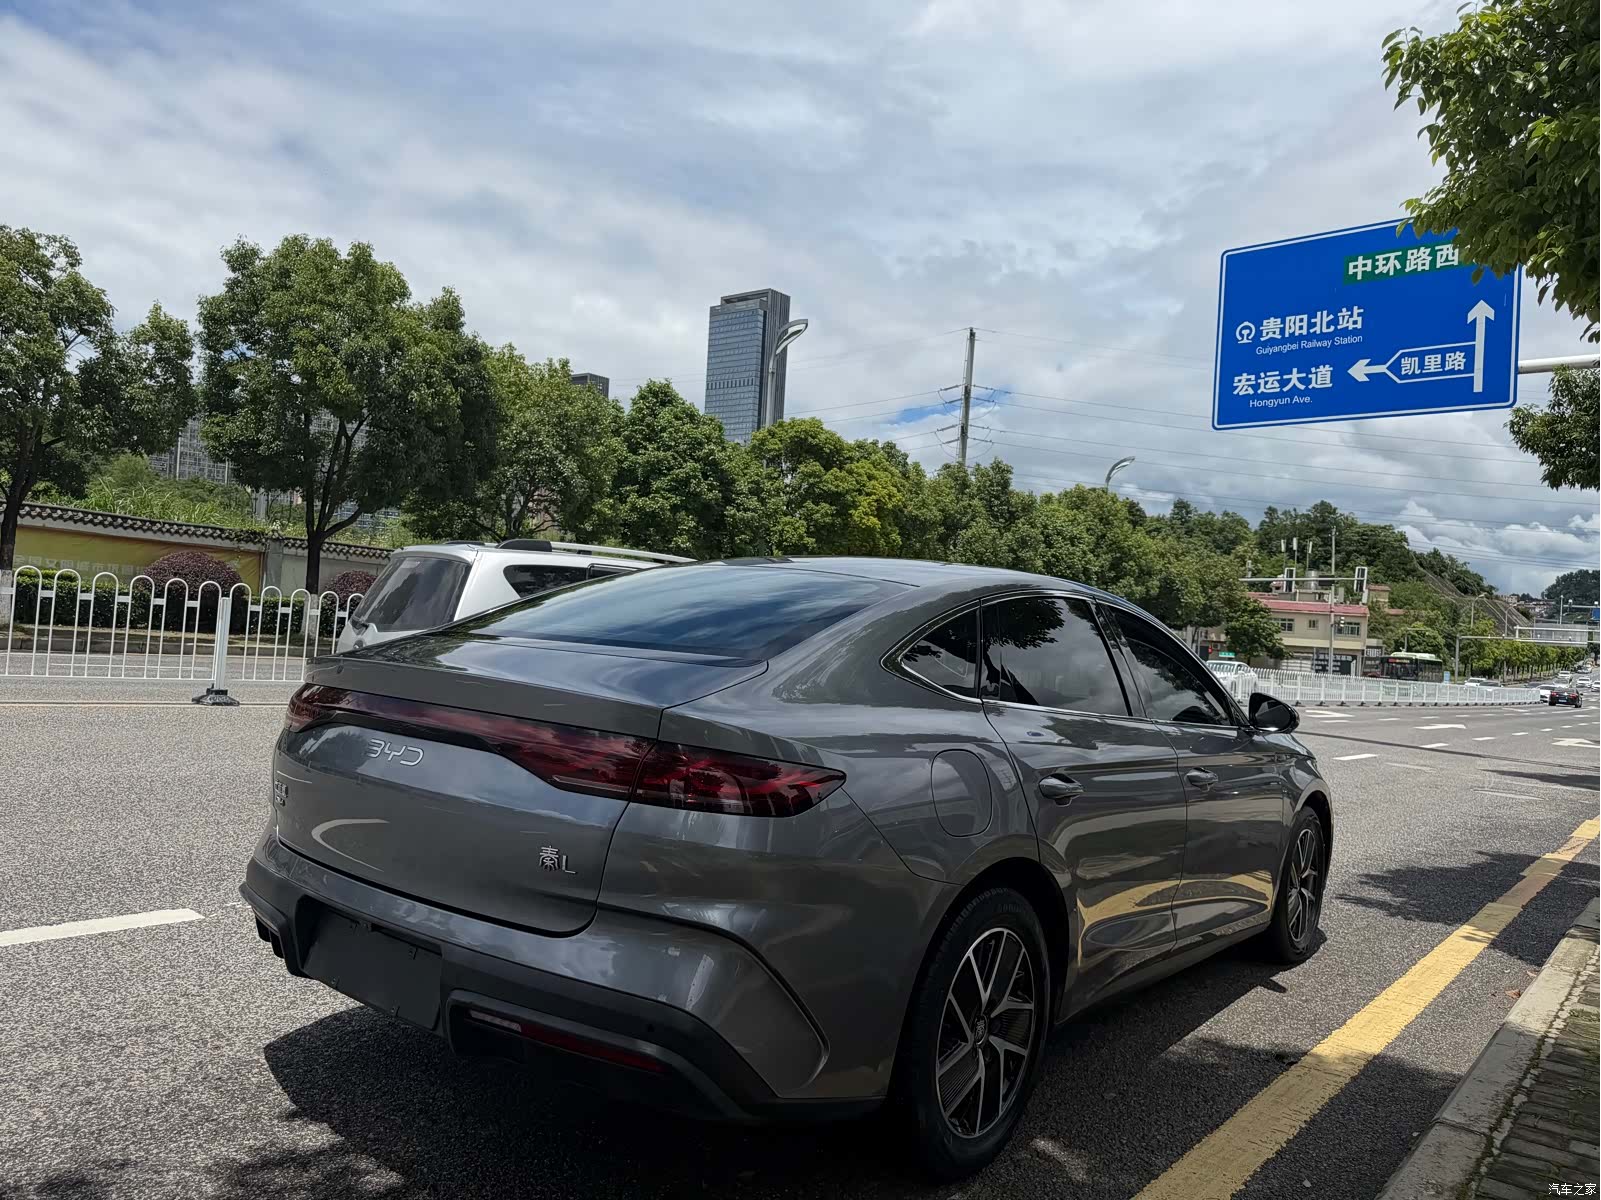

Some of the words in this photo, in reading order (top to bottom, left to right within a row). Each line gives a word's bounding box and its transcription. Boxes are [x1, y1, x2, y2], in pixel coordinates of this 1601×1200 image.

[1348, 244, 1459, 280] 中环路西
[1260, 306, 1364, 341] 贵阳北站
[1256, 342, 1299, 355] Guiyangbei
[1301, 339, 1332, 349] Railway
[1334, 335, 1363, 346] Station
[1401, 351, 1466, 375] 凯里路
[1233, 364, 1333, 395] 宏运大道
[1249, 397, 1290, 408] Hongyun
[1292, 395, 1313, 404] Ave.
[369, 739, 424, 766] BYD
